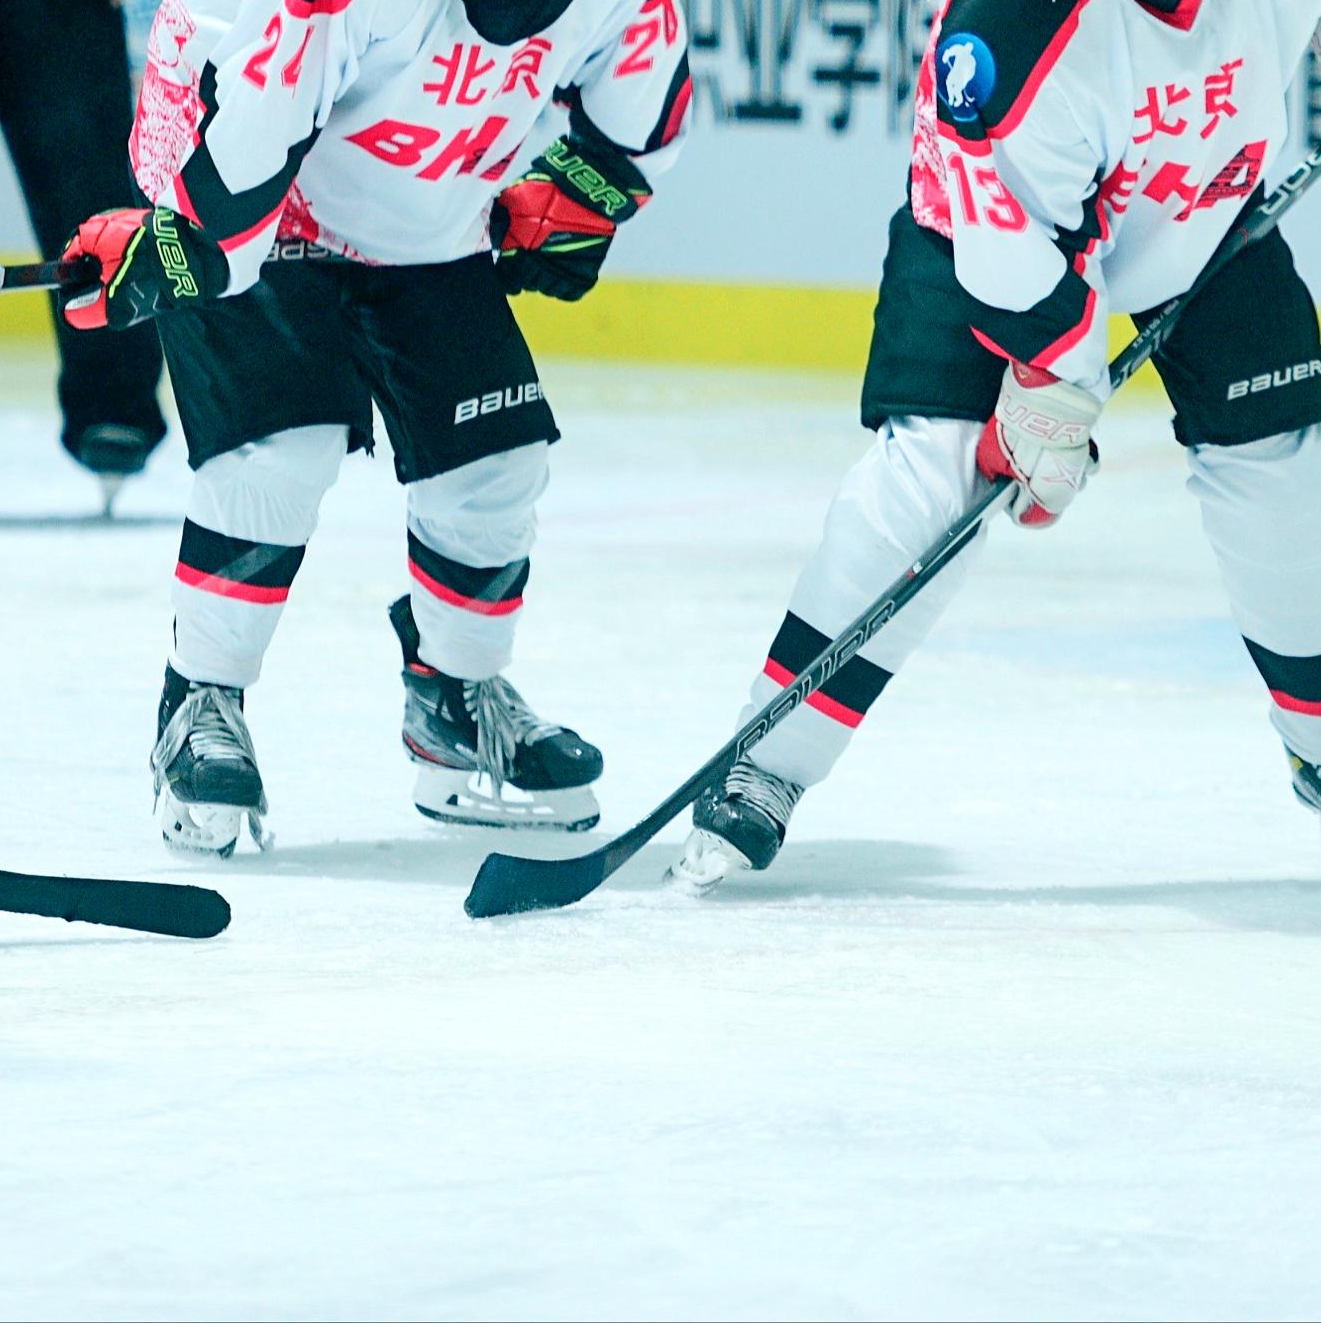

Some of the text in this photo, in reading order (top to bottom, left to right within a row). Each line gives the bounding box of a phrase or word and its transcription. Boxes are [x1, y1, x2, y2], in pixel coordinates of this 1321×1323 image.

[423, 37, 553, 106] 北京
[544, 138, 629, 217] UER
[152, 205, 199, 299] UER
